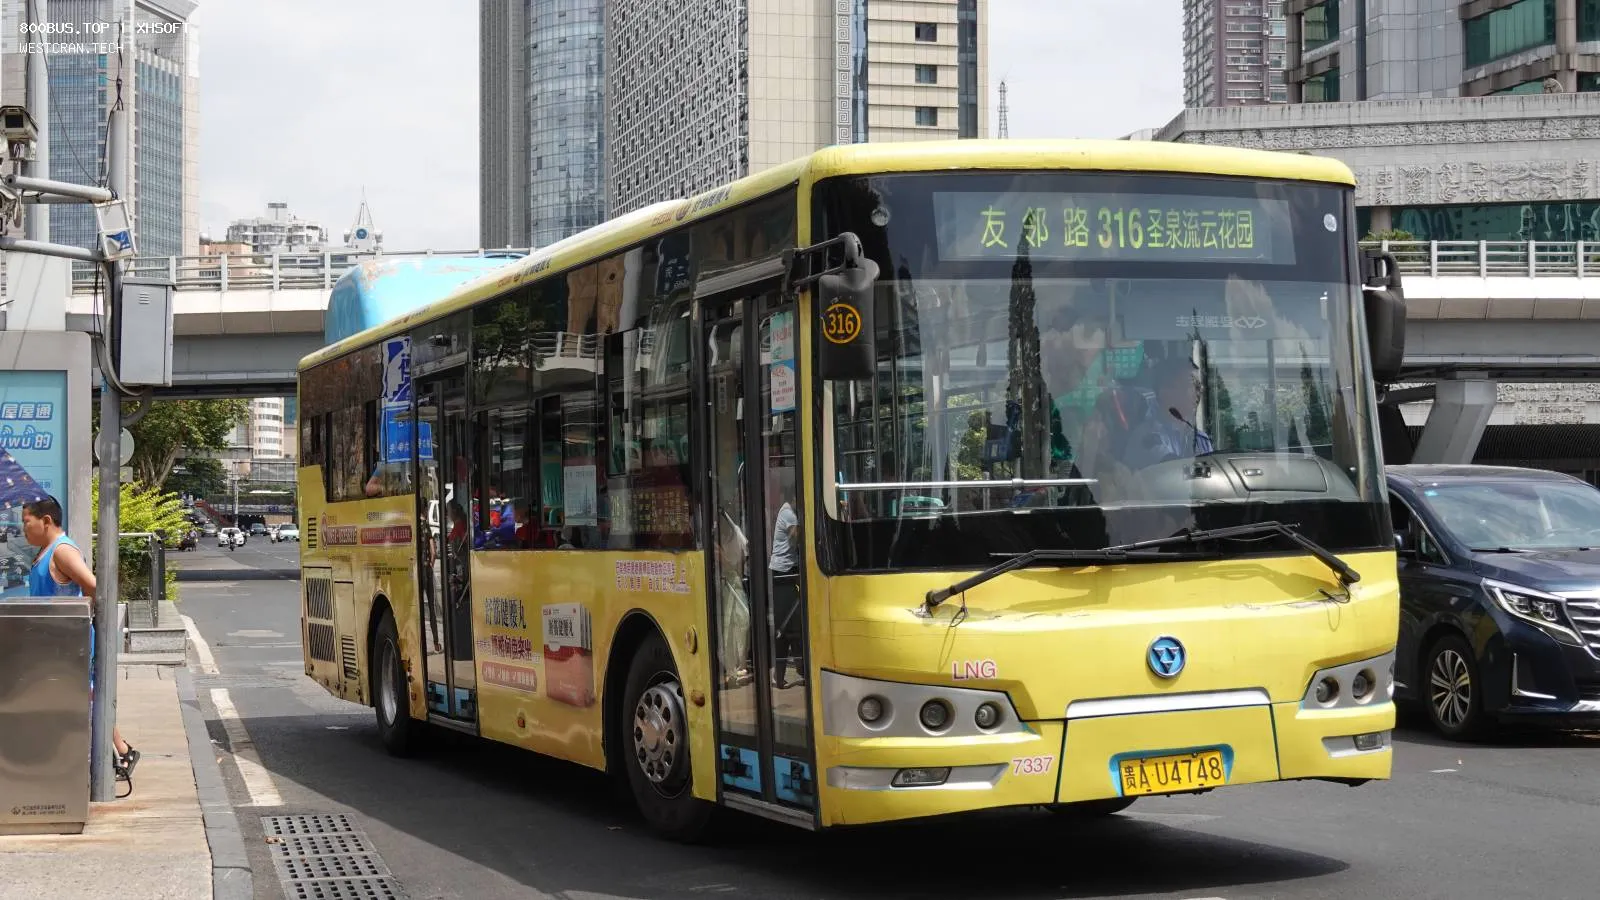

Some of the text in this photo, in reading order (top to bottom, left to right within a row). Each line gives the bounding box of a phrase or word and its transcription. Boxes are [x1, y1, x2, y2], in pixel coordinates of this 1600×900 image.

[1097, 207, 1144, 249] 316
[1147, 208, 1254, 249] 圣泉流云花园
[827, 312, 854, 335] 316
[952, 660, 996, 681] LNG
[1012, 756, 1054, 776] 7337
